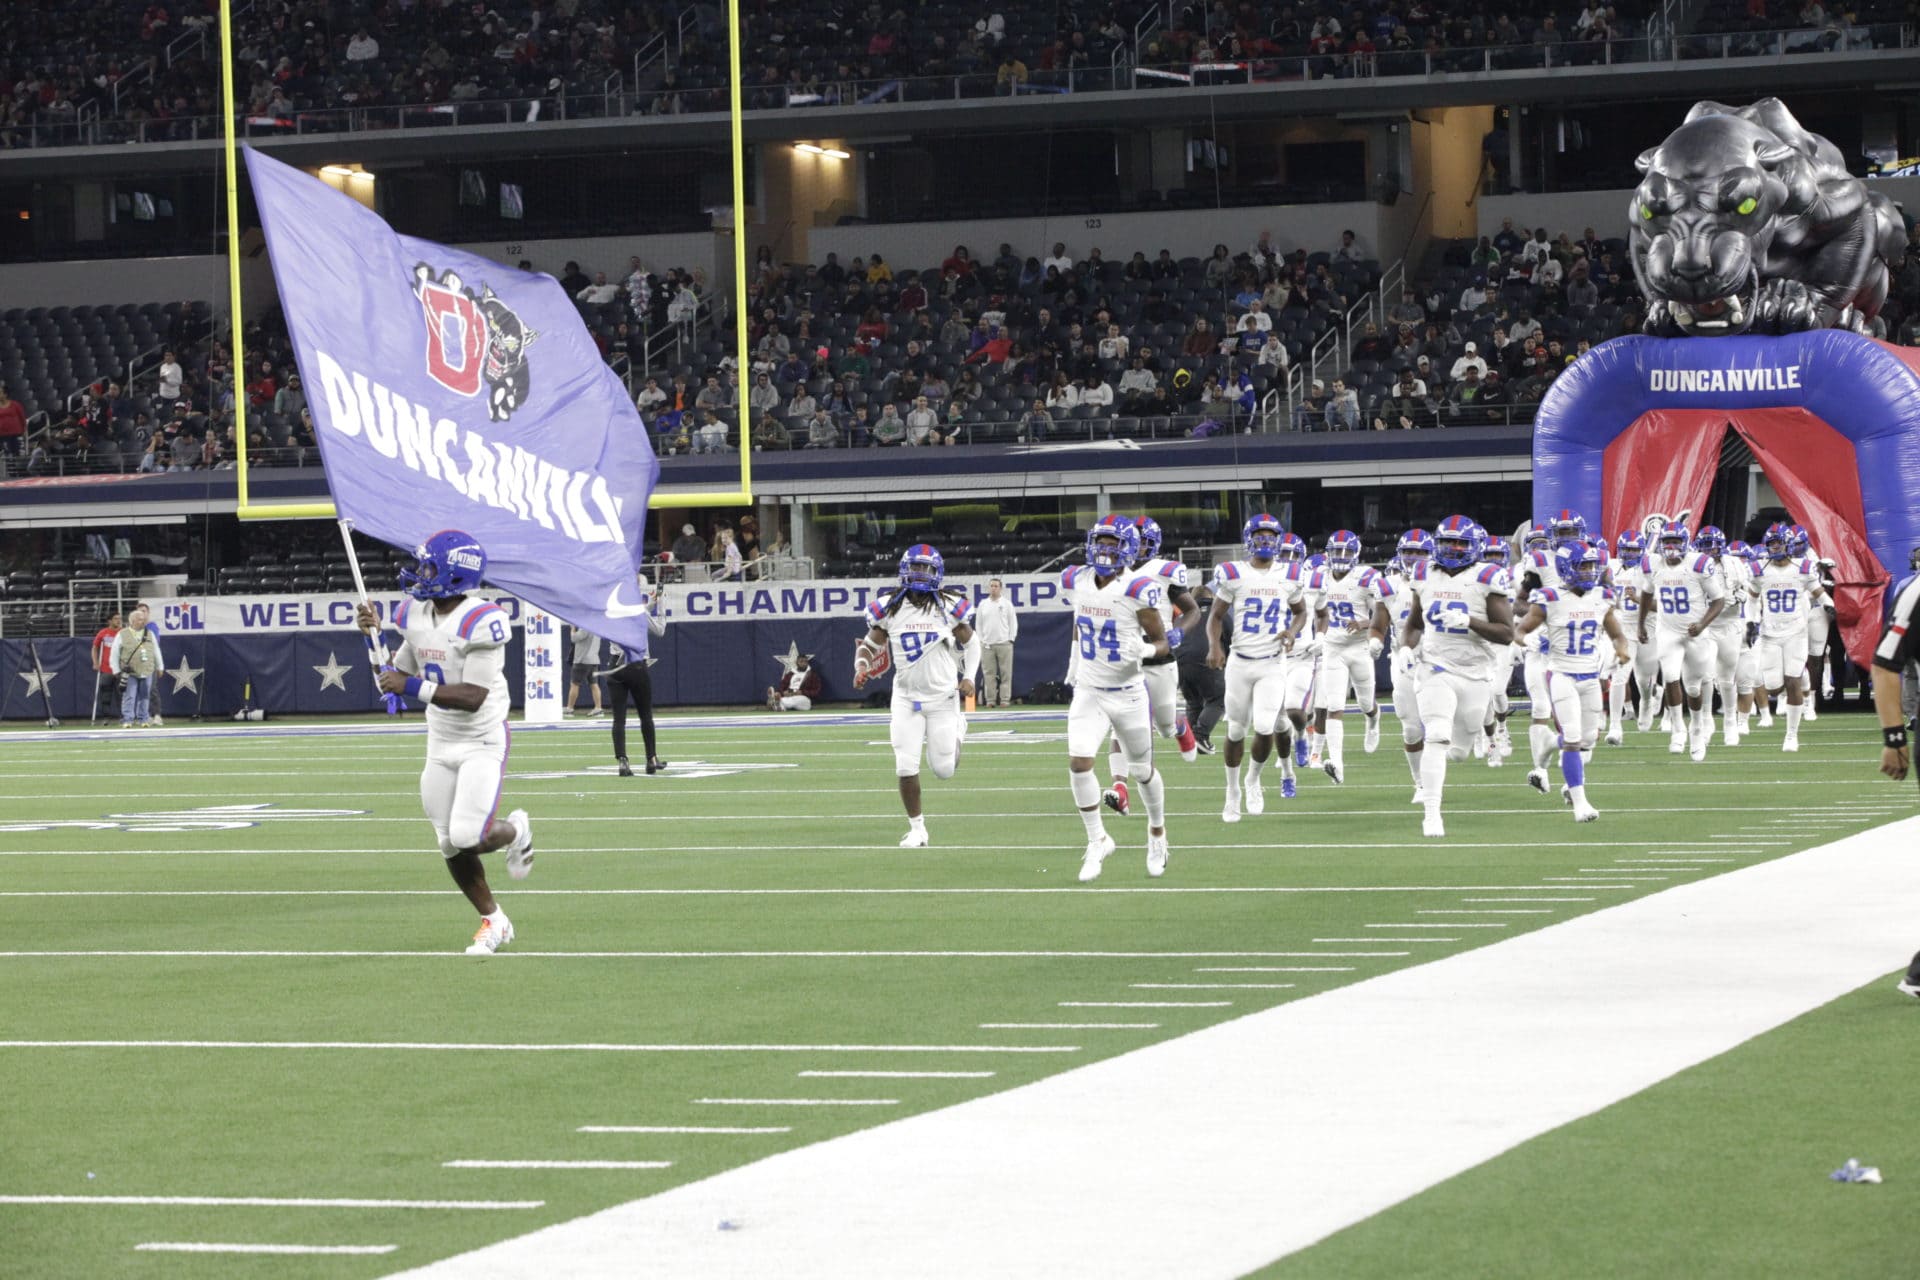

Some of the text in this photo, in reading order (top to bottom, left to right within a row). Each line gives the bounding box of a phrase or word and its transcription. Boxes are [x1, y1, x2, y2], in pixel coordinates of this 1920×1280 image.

[1085, 218, 1102, 229] 123
[505, 245, 522, 255] 122
[1650, 366, 1801, 392] DUNCANVILLE
[448, 550, 483, 570] PANTHERS
[1081, 605, 1112, 617] PANTHERS
[1660, 587, 1690, 614] 68
[1767, 589, 1797, 613] 80
[164, 602, 204, 631] UIL
[1242, 597, 1280, 634] 24
[489, 619, 505, 642] 8
[1077, 615, 1121, 662] 84
[1566, 620, 1598, 655] 12
